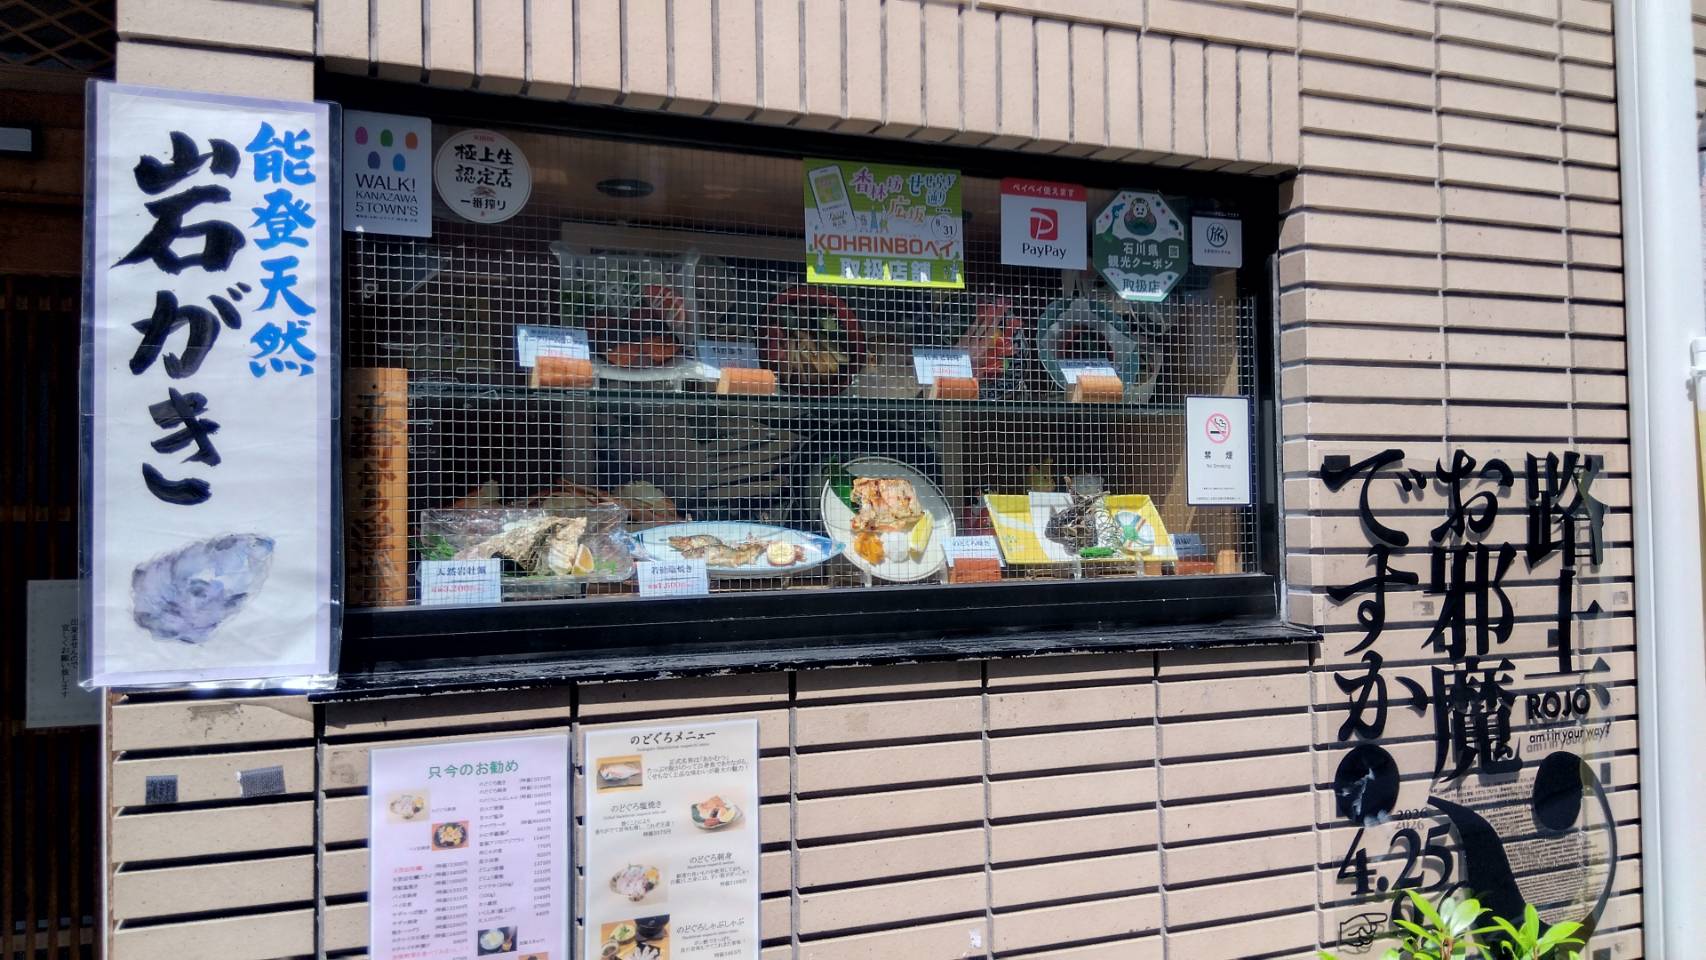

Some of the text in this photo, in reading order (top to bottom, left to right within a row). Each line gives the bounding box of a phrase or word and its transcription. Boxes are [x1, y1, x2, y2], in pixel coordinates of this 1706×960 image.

[455, 144, 514, 166] 極上生
[355, 172, 416, 193] WALK!
[455, 164, 513, 189] 認定店
[355, 190, 418, 205] KANAZAWA
[460, 197, 506, 211] 一番搾り
[245, 121, 317, 378] 能登天然
[1022, 242, 1067, 259] PayPay
[1123, 242, 1160, 258] 石川県
[1108, 254, 1174, 270] 観光クーポン
[110, 131, 252, 506] 岩がき
[1320, 448, 1432, 742] ですか
[1420, 448, 1530, 782] お邪魔
[1526, 688, 1591, 720] ROJO
[631, 731, 716, 745] のどぐろメニュー
[1529, 733, 1545, 744] am
[1562, 729, 1585, 744] your
[428, 759, 519, 779] 只今のお勧め
